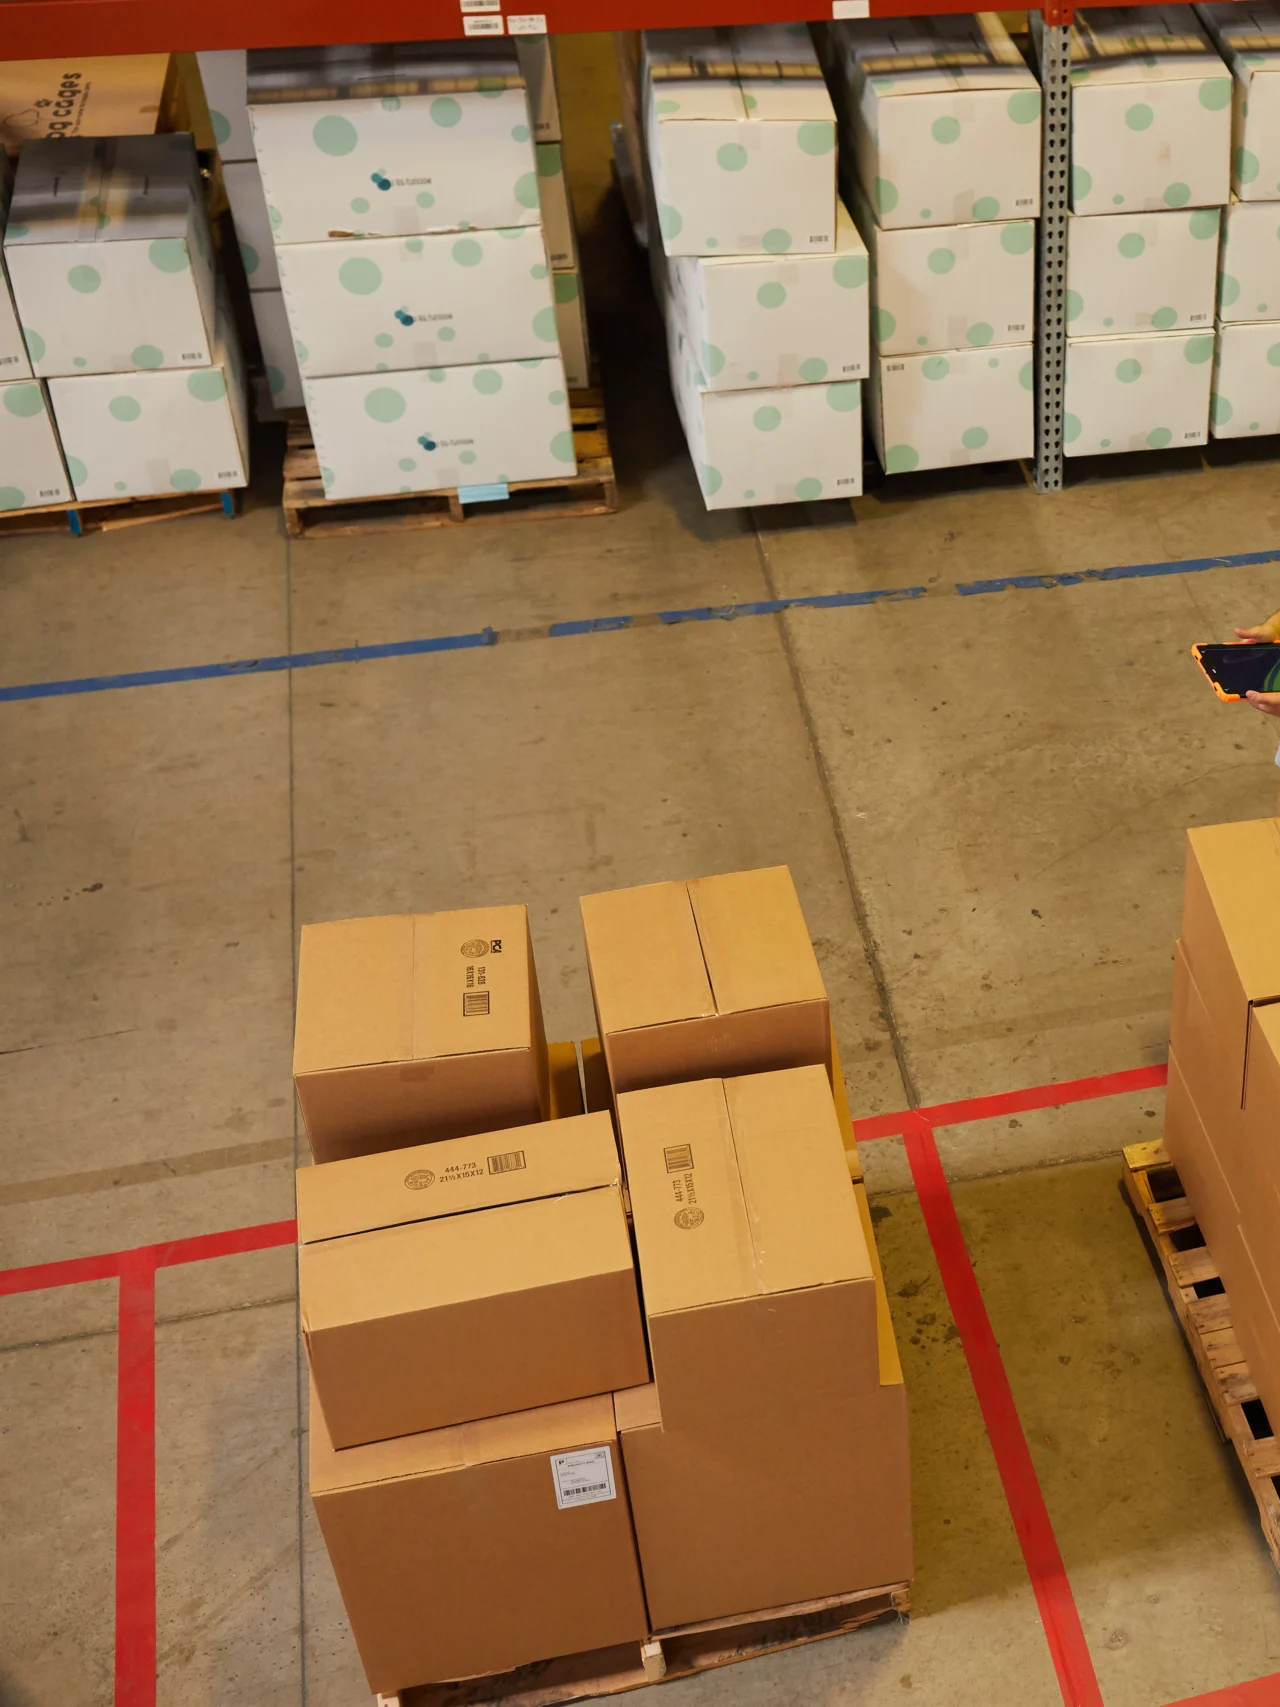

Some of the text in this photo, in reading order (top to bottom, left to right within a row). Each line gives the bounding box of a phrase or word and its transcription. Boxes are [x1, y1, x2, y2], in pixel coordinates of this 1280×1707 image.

[53, 72, 82, 117] cages
[46, 121, 73, 139] og
[491, 939, 502, 954] PCA
[466, 965, 475, 989] 16X16X16
[477, 966, 486, 986] 131-628
[439, 1168, 484, 1183] 21½X15X12
[444, 1162, 477, 1174] 444-773
[672, 1179, 684, 1203] 444-773
[684, 1172, 697, 1205] 21½X15X12
